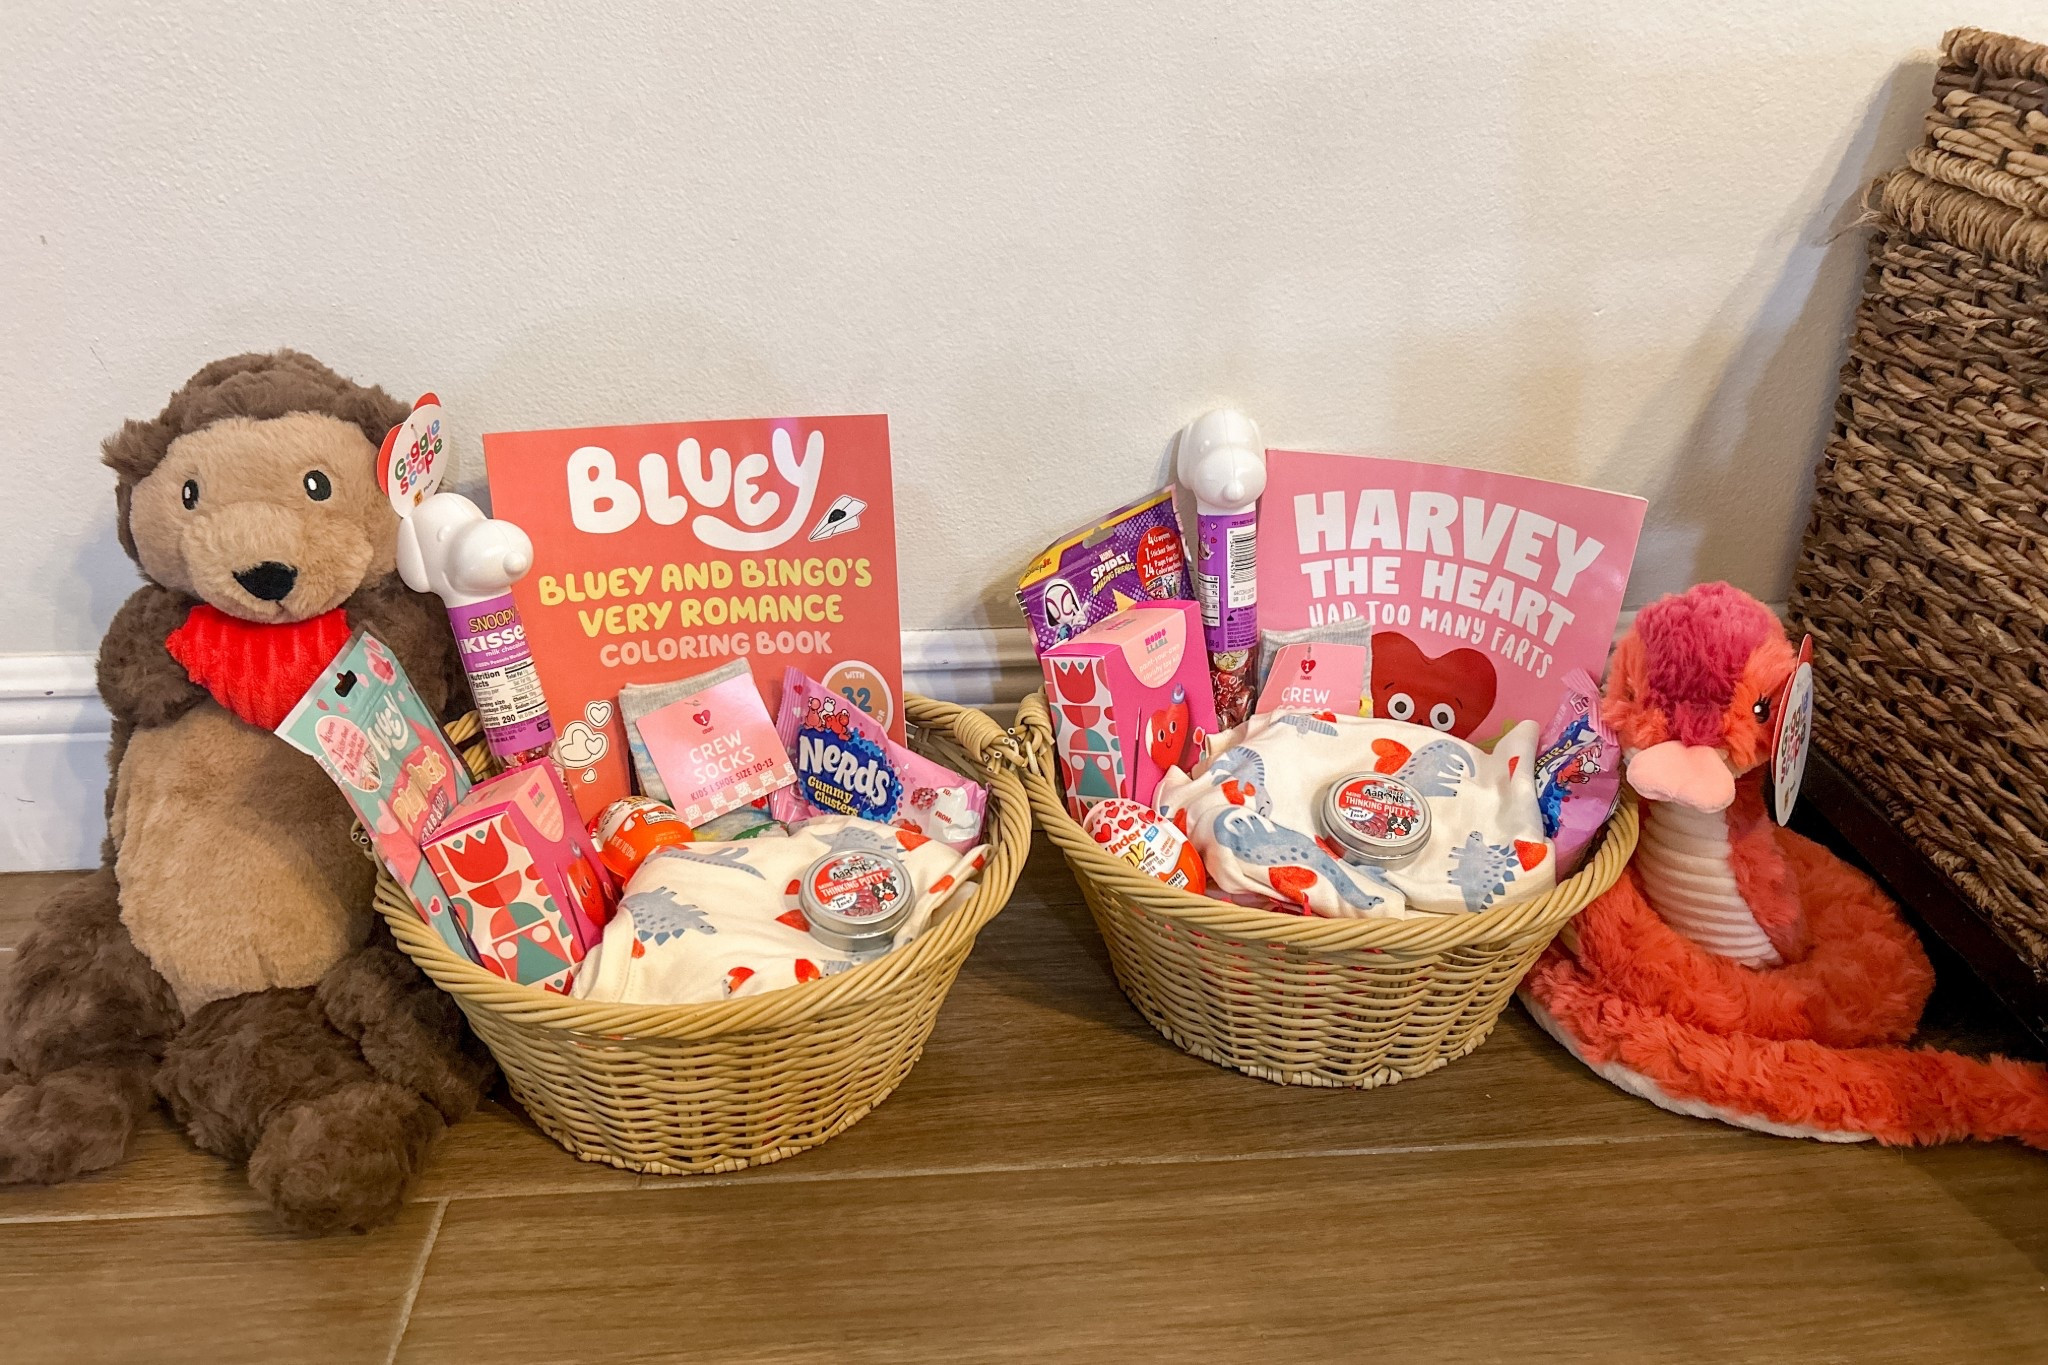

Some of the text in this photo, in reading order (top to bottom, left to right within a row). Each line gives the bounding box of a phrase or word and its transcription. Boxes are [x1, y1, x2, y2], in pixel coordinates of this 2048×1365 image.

[1147, 533, 1154, 545] 4
[1293, 489, 1605, 597] HARVEY
[1145, 548, 1150, 561] 1
[1090, 551, 1131, 585] SPIDEY
[1143, 562, 1154, 578] 24
[538, 557, 872, 606] BLUEY AND BINGO'S
[1300, 556, 1575, 647] THE HEART
[469, 607, 515, 632] SNOOPY
[578, 594, 844, 638] VERY ROMANCE
[486, 640, 526, 657] milk chocolate
[600, 631, 833, 667] COLORING BOOK
[1308, 601, 1553, 679] HAD TOO MANY FARTS
[470, 670, 500, 681] Nutrition
[844, 670, 865, 680] WITH
[1304, 662, 1310, 671] 1
[472, 680, 490, 688] Facts
[1281, 686, 1331, 705] CREW
[502, 714, 516, 724] 290
[700, 716, 707, 724] 1
[690, 729, 742, 764] CREW
[694, 746, 755, 784] SOCKS
[690, 787, 708, 800] KIDS
[716, 775, 735, 790] SHOE
[735, 767, 752, 781] SIZE
[753, 758, 774, 773] 10-13
[807, 775, 853, 804] Gummy
[814, 790, 859, 817] Clusters
[942, 788, 952, 796] TO:
[934, 810, 952, 824] FROM:
[1345, 796, 1410, 817] THINKING PUTTY
[1105, 829, 1141, 854] inder
[821, 872, 886, 897] THINKING PUTTY
